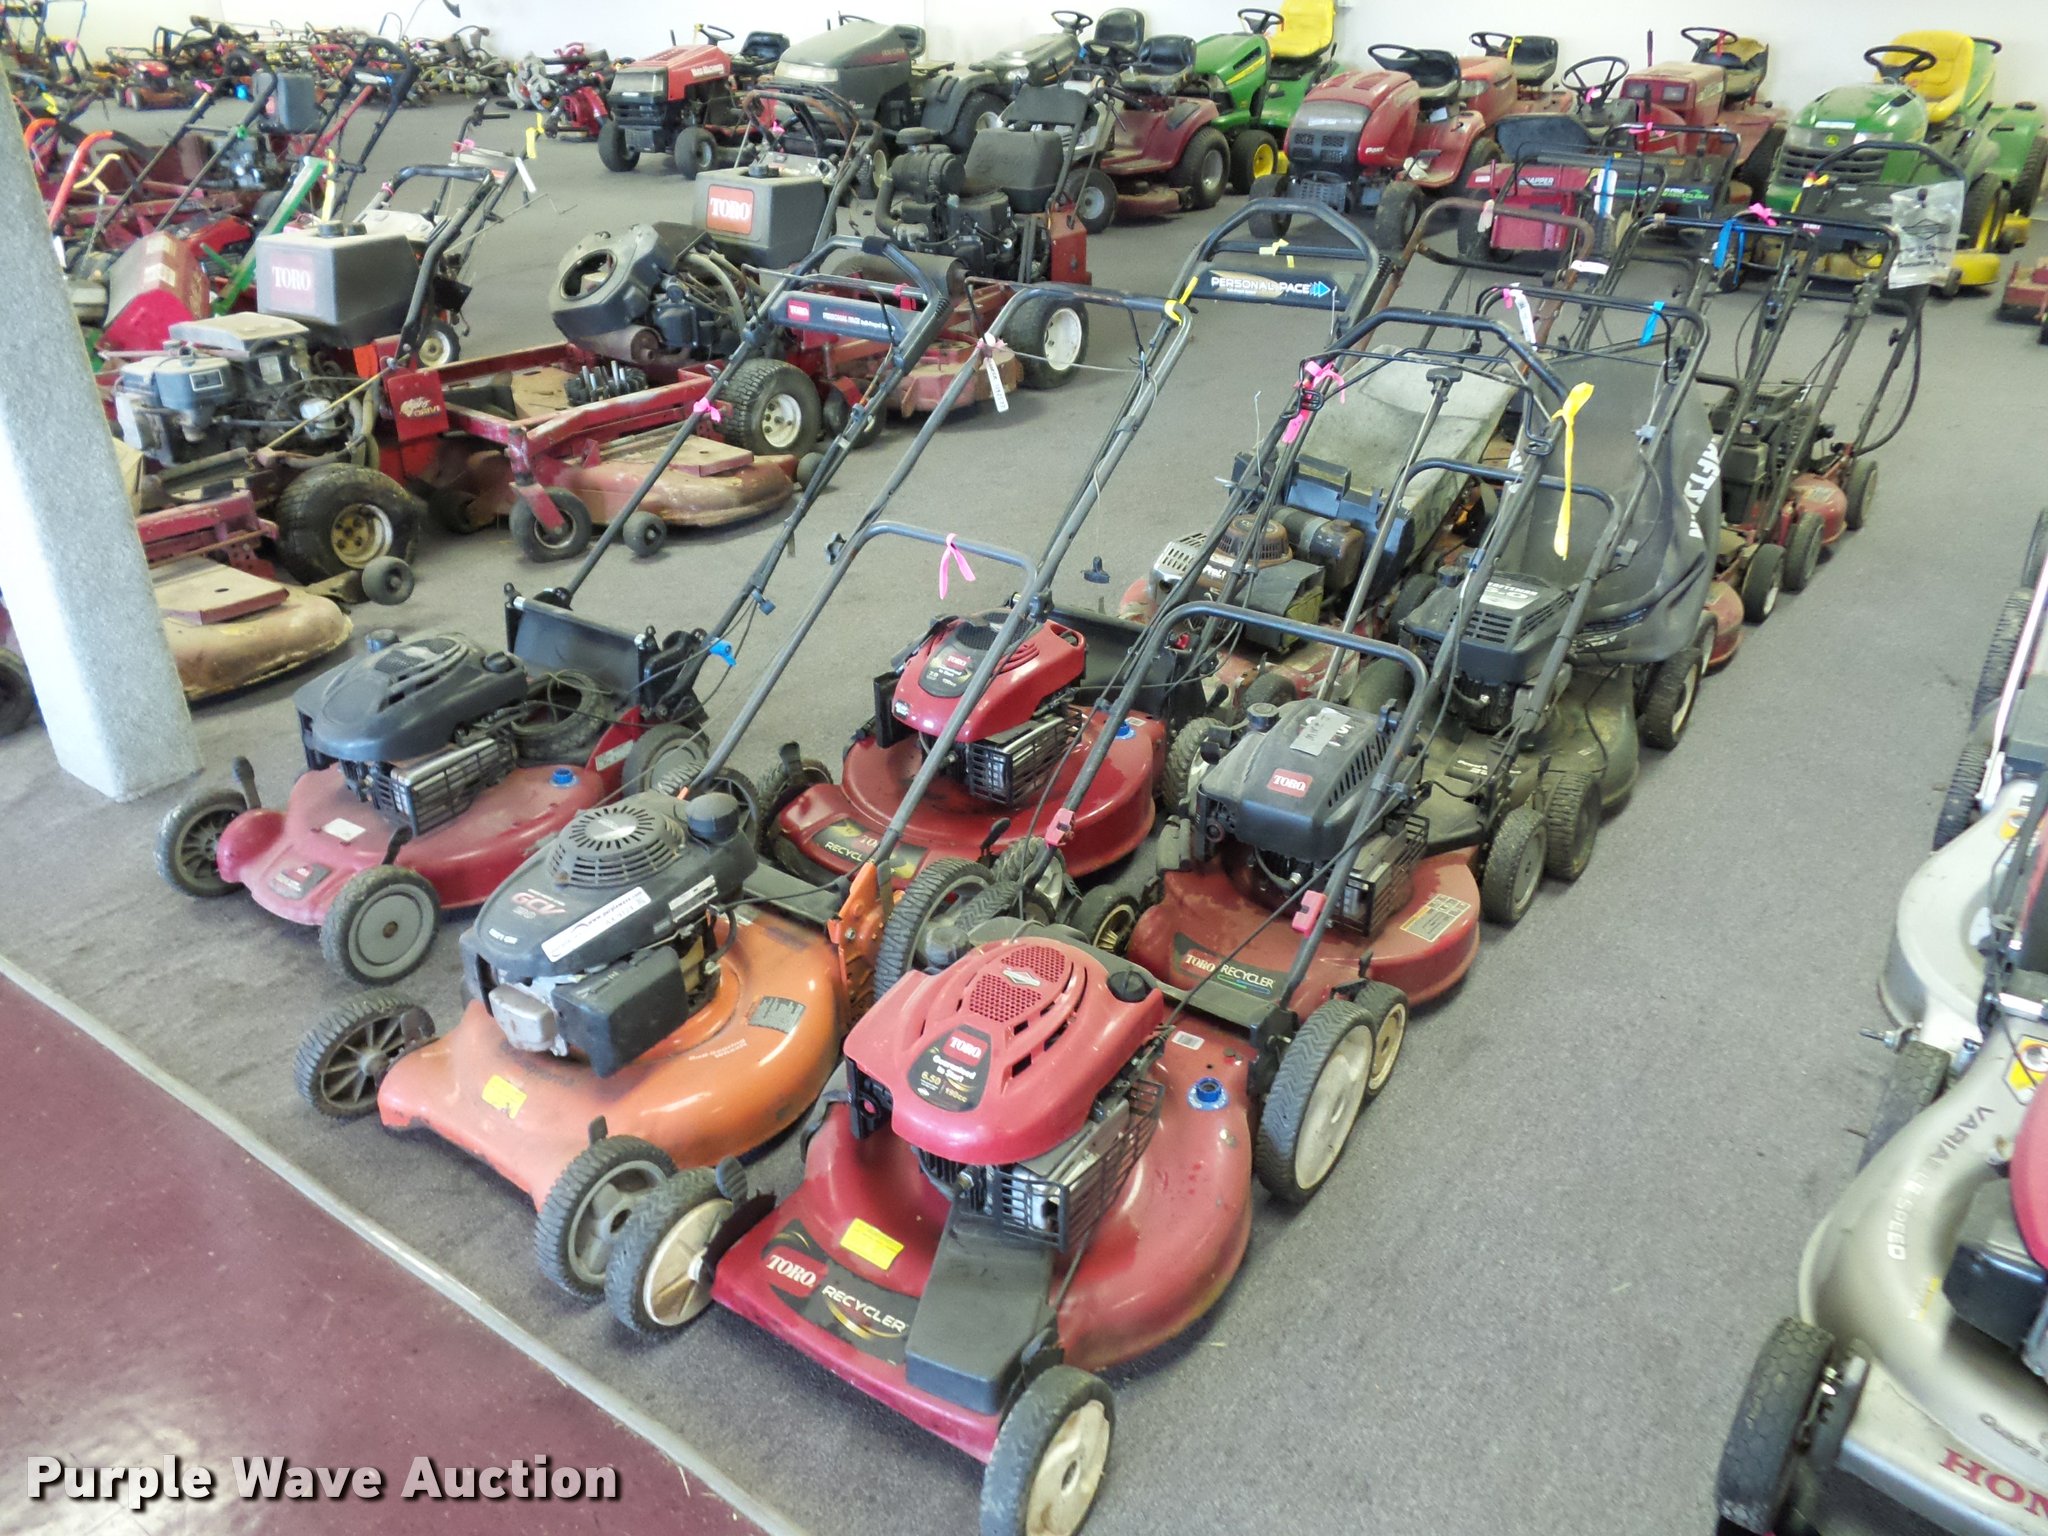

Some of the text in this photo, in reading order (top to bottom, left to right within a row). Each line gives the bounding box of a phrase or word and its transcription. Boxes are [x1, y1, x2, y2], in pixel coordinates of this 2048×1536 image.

[710, 198, 750, 220] TORO
[272, 265, 312, 292] TORO
[1211, 276, 1311, 294] PERSONAL PACE
[946, 655, 967, 667] TORO
[1273, 774, 1306, 792] TORO
[824, 841, 863, 862] RECYCL
[511, 892, 566, 915] GCV
[1185, 954, 1275, 989] TORO RECYCLER
[949, 1036, 982, 1059] TORO
[766, 1254, 907, 1333] TORO RECYCLER
[1938, 1446, 2048, 1520] HON
